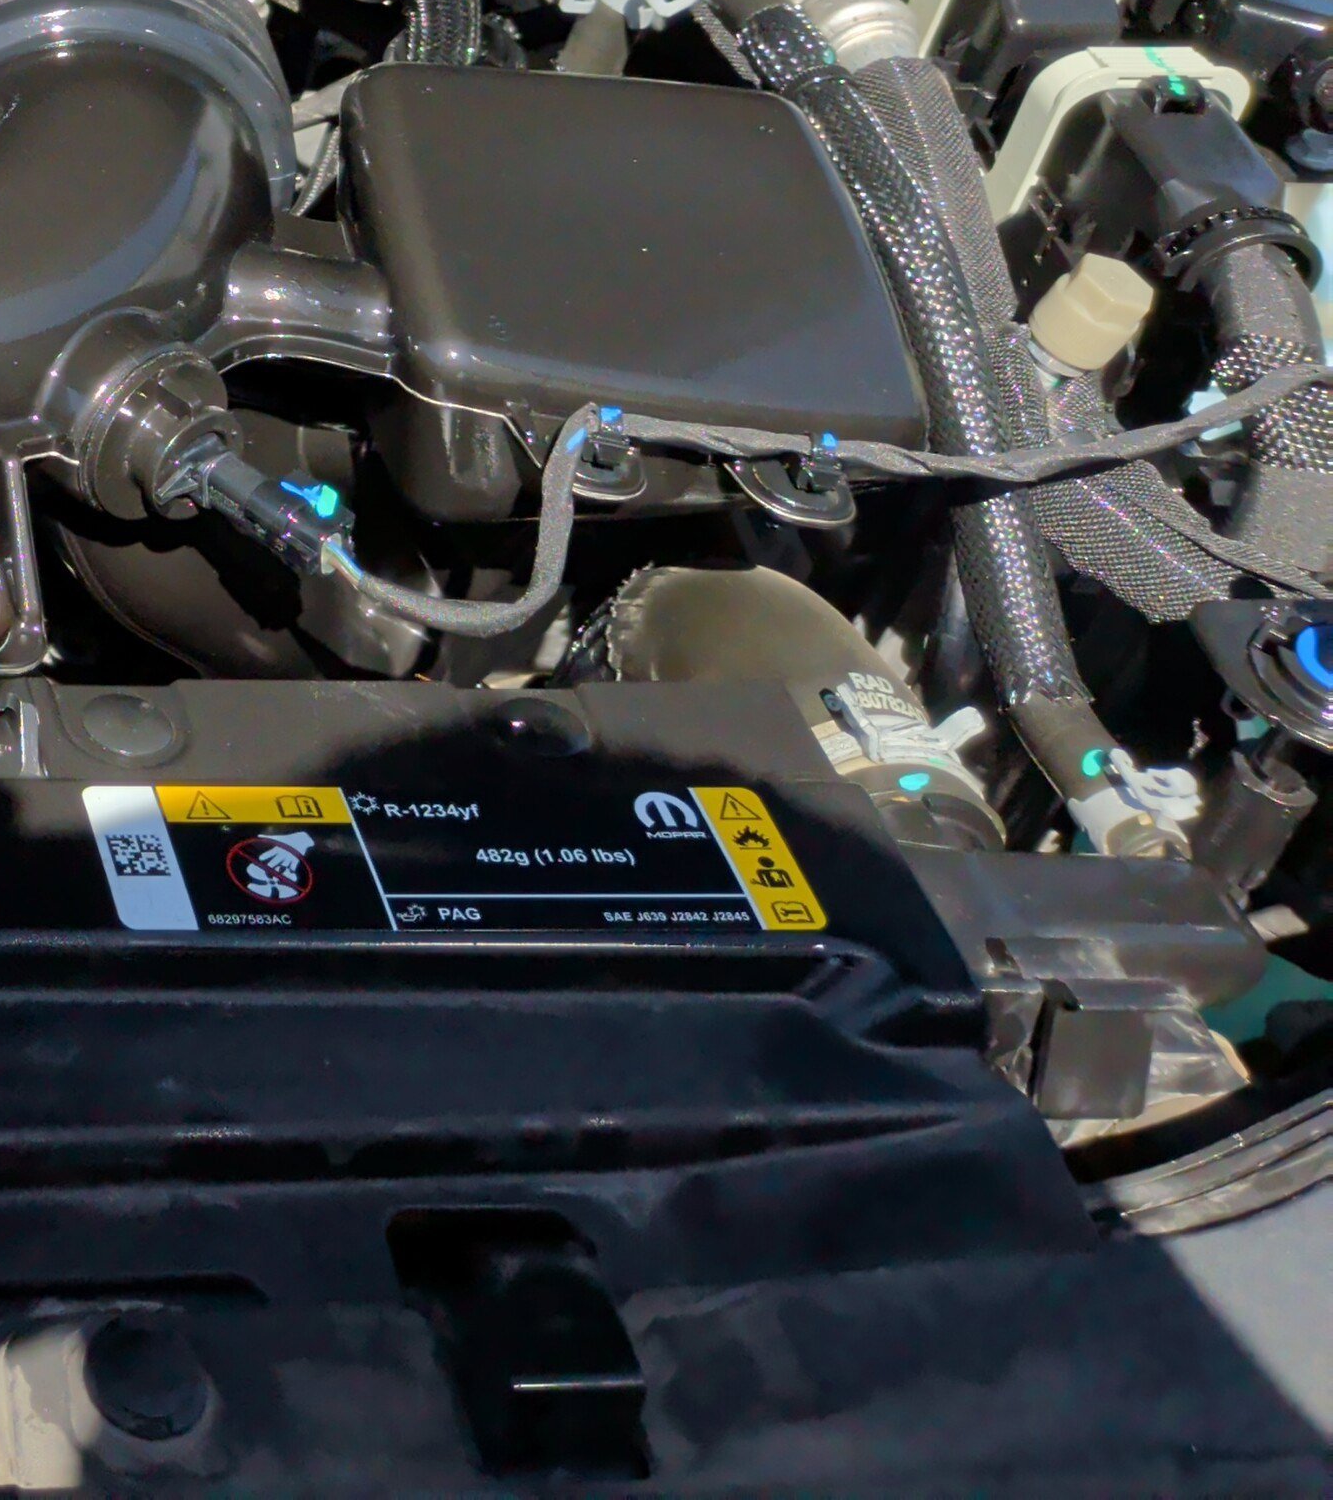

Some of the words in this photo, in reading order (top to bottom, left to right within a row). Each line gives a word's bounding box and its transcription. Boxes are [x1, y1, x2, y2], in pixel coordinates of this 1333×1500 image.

[848, 671, 894, 694] RAD
[383, 803, 480, 821] R-1234yf
[646, 831, 707, 839] MOPAR
[475, 848, 530, 866] 482g
[534, 848, 588, 866] (1.06
[591, 848, 636, 867] lbs)
[207, 913, 292, 926] 68297583AC
[437, 907, 481, 921] PAG
[603, 911, 633, 922] SAE
[636, 911, 667, 922] J639
[670, 911, 709, 922] J2842
[712, 911, 751, 922] J2845
